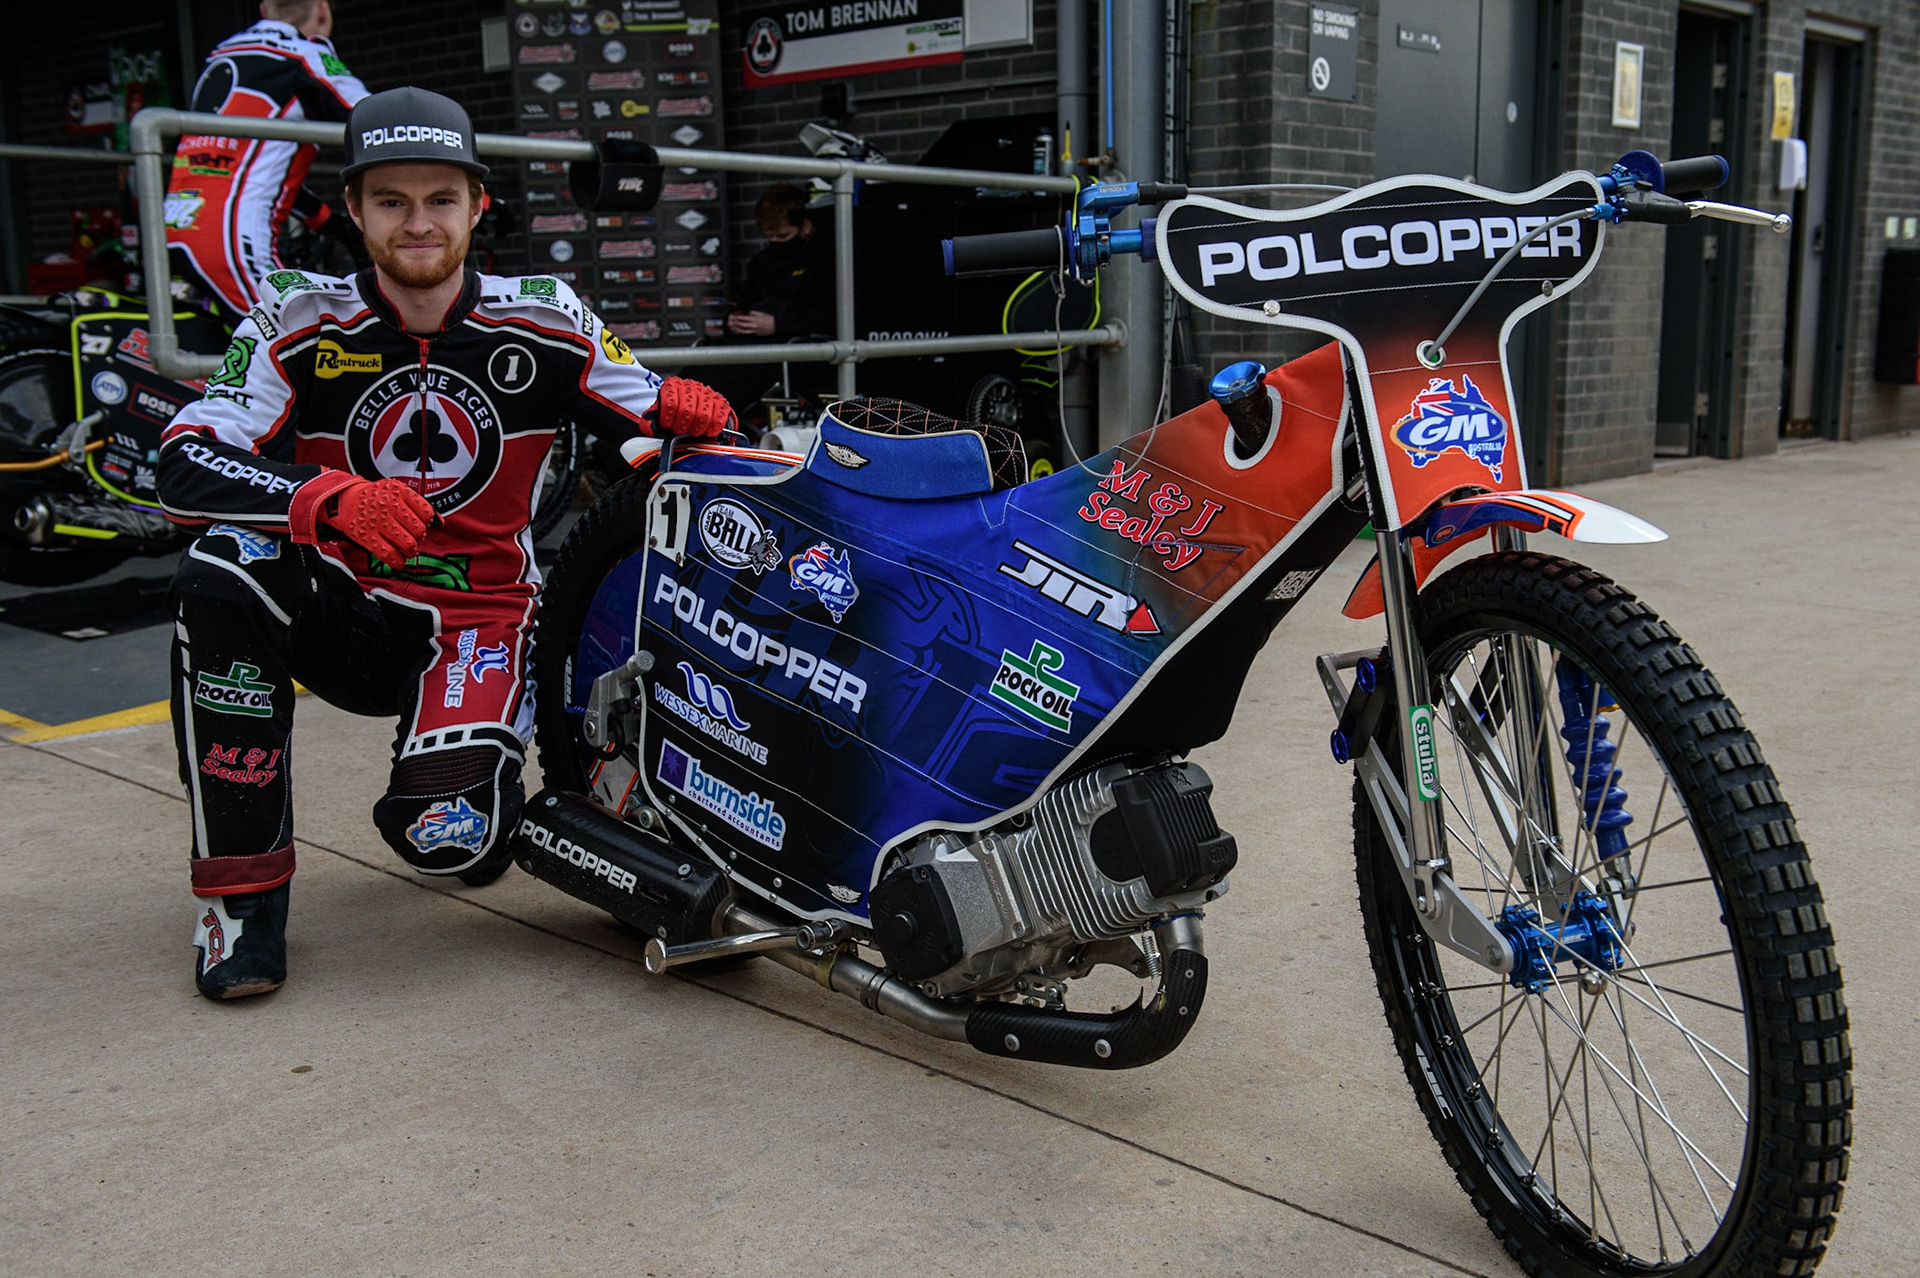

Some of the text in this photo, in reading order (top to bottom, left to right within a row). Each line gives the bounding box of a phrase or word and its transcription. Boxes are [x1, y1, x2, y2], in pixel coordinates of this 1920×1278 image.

[785, 0, 918, 34] TOM BRENNAN
[1312, 22, 1350, 40] OR VAPING
[1313, 9, 1356, 28] NO SMOKING
[362, 125, 463, 149] POLCOPPER
[1198, 215, 1583, 288] POLCOPPER
[317, 348, 380, 369] Rentruck
[504, 355, 520, 382] 1
[137, 392, 176, 417] BOSS
[355, 372, 493, 430] BELLE VUE ACES
[1409, 412, 1490, 446] GM
[716, 503, 735, 519] TEAM
[1098, 459, 1224, 537] M & J
[661, 491, 678, 549] 1
[707, 511, 757, 556] BALL
[1077, 490, 1204, 571] Sealey
[796, 563, 846, 595] GM
[653, 573, 868, 714] POLCOPPER
[197, 682, 272, 707] ROCK OIL
[997, 665, 1072, 719] ROCK OIL
[207, 742, 282, 770] M & J
[1416, 722, 1436, 785] stuha
[200, 757, 278, 788] Sealey
[689, 761, 784, 838] burnside
[417, 817, 475, 841] GM
[688, 789, 781, 848] chartered accountants
[518, 818, 638, 895] POLCOPPER
